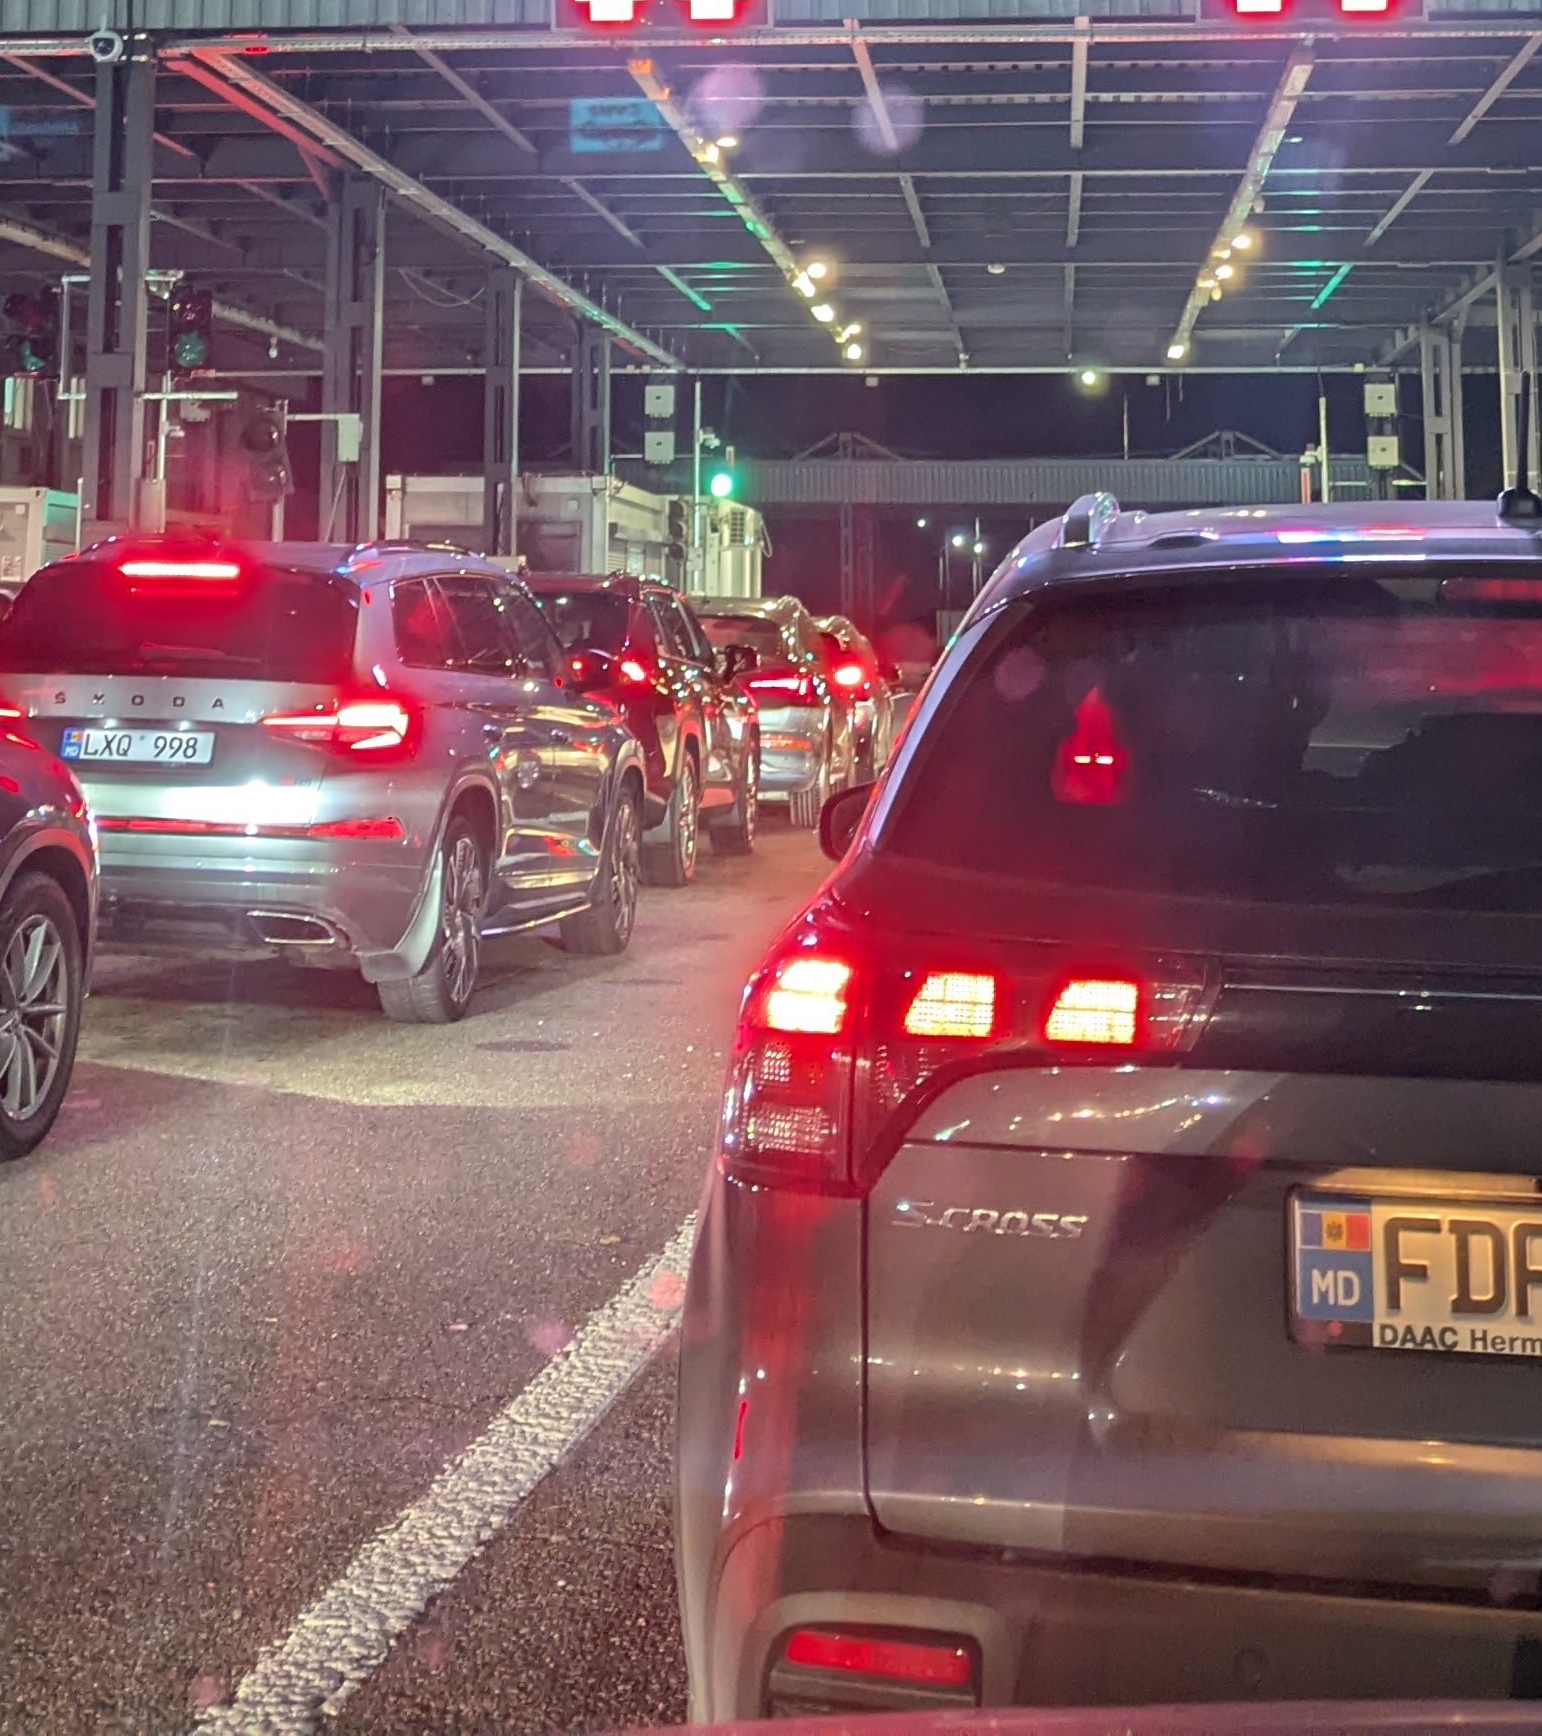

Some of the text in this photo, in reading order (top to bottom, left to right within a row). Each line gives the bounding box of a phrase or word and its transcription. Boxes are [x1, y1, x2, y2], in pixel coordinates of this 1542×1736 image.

[64, 746, 79, 757] MD
[83, 733, 198, 759] LXQ 998
[1311, 1268, 1360, 1306] MD
[1379, 1324, 1459, 1349] DAAC
